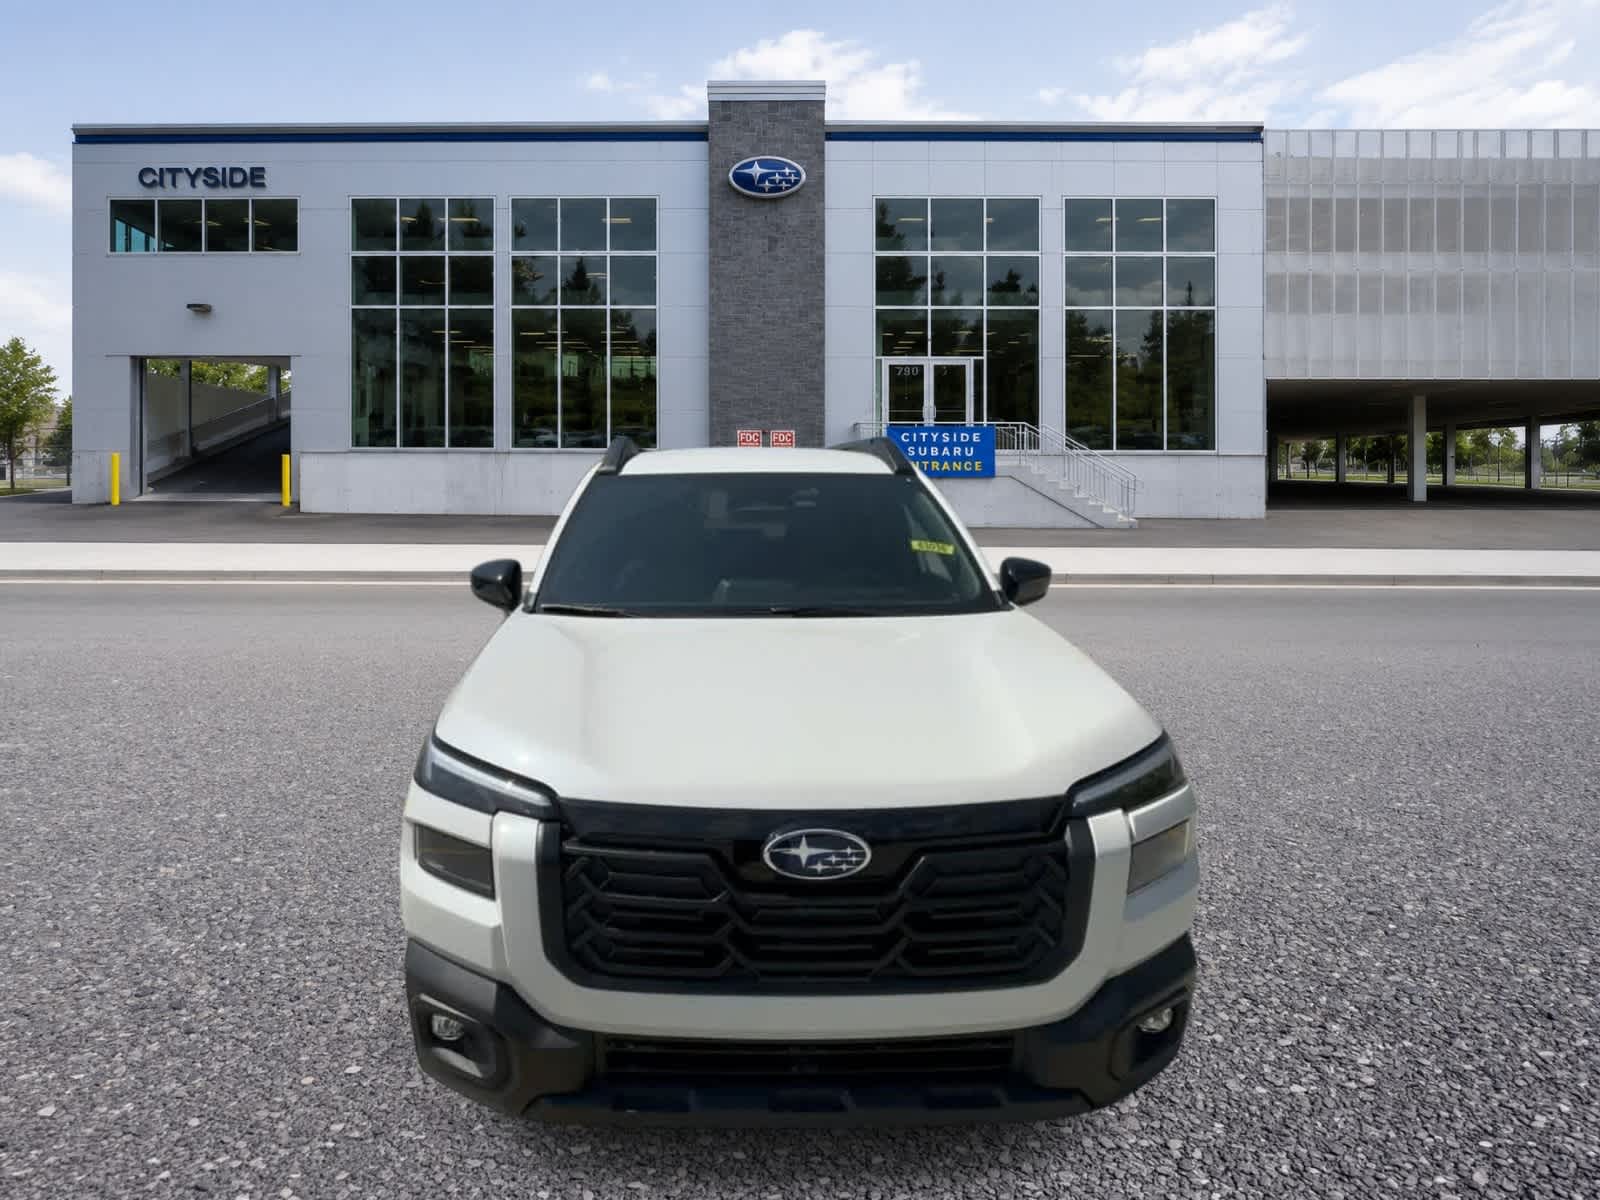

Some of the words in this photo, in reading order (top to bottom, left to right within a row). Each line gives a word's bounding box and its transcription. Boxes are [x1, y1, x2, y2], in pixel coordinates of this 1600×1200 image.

[138, 167, 266, 188] CITYSIDE
[895, 366, 919, 376] 790
[740, 432, 760, 442] FDC
[773, 432, 792, 442] FDC
[900, 432, 981, 442] CITYSIDE
[907, 446, 974, 457] SUBARU
[910, 461, 983, 472] NTRANCE
